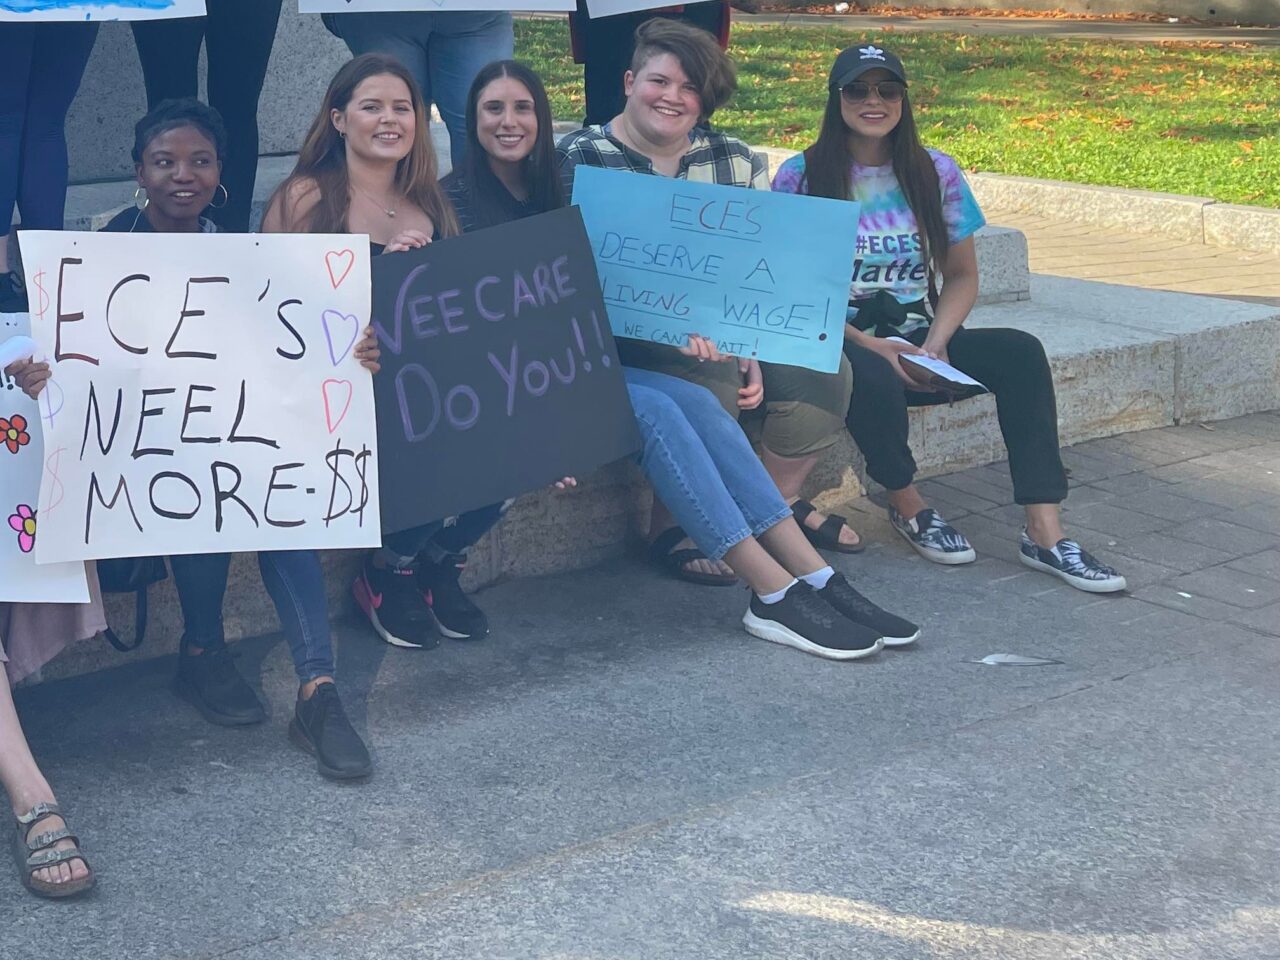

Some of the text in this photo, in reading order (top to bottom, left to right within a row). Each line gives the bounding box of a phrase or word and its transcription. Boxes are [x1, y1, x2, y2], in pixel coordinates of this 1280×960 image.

[598, 232, 776, 285] DESERVE A
[856, 232, 924, 255] #ECES
[475, 255, 577, 321] CARE
[603, 278, 831, 341] LIVING WAGE!
[624, 321, 645, 338] WE
[717, 337, 759, 357] AIT!
